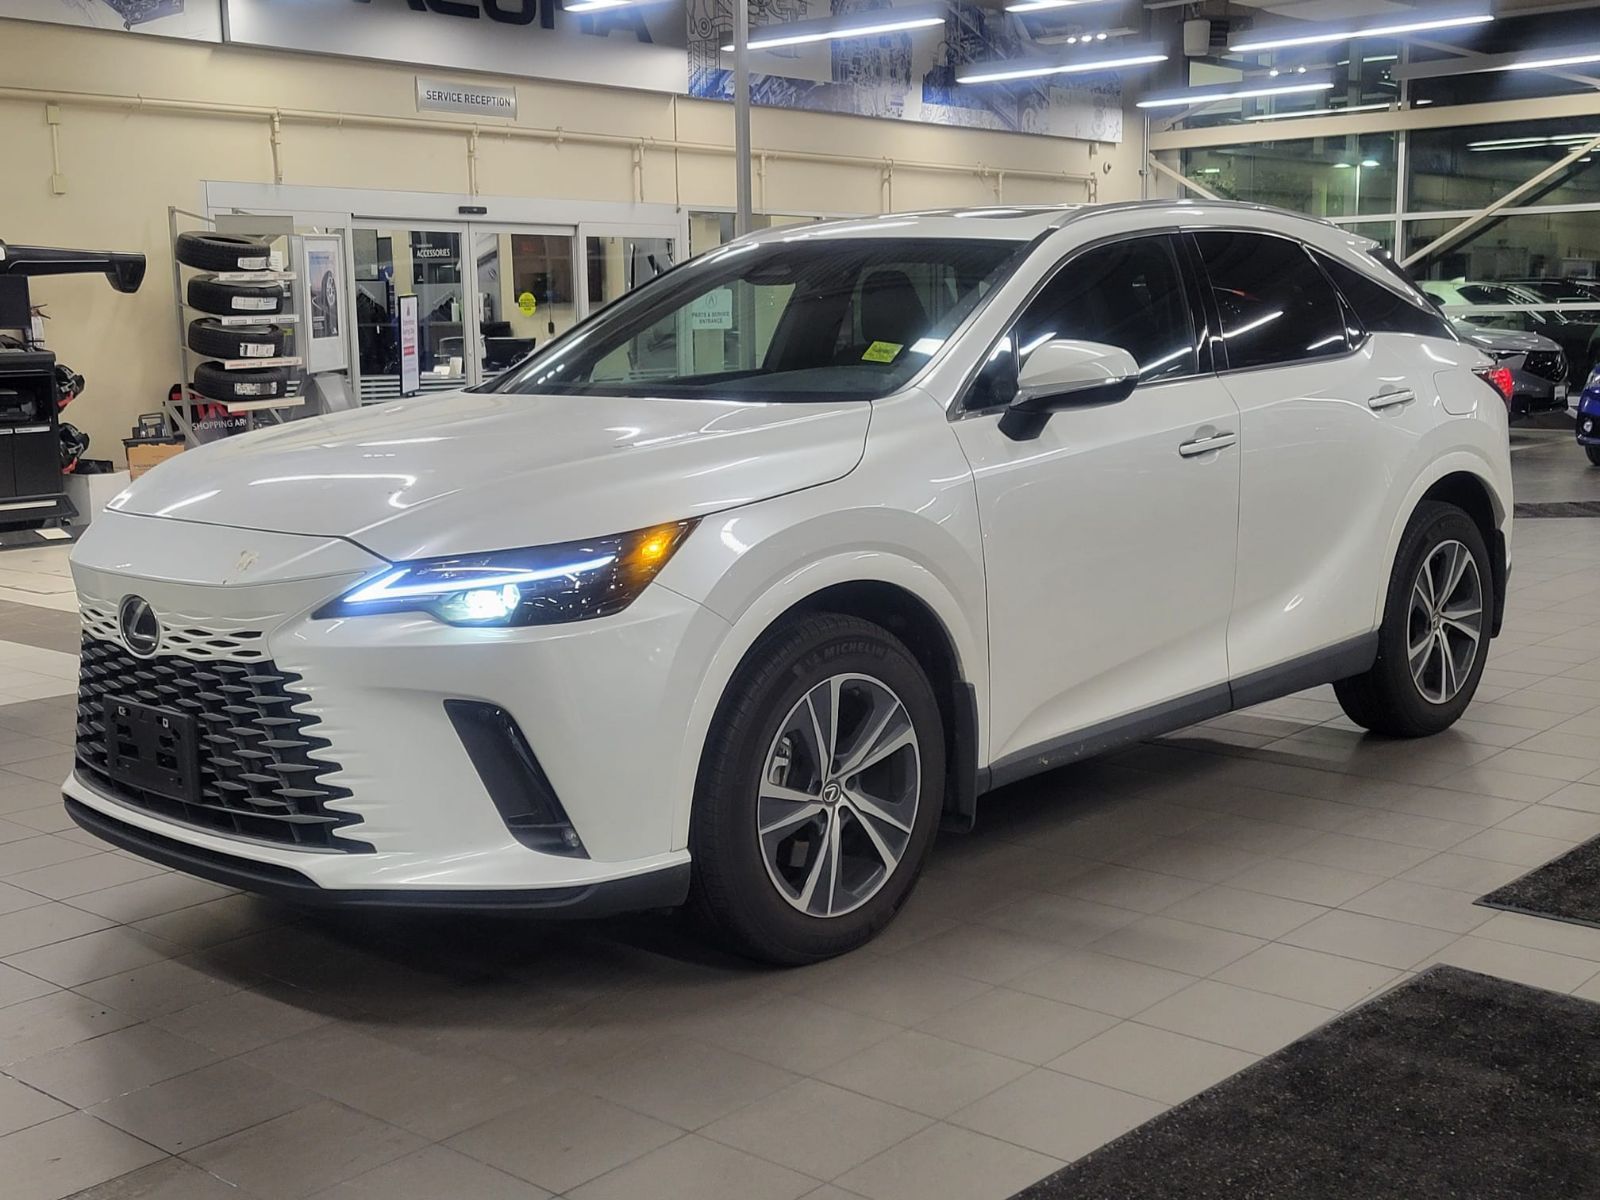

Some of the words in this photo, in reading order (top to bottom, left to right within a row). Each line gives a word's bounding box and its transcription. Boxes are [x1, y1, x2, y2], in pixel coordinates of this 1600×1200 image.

[426, 90, 463, 103] SERVICE
[464, 93, 511, 107] RECEPTION
[416, 248, 450, 258] ACCESSORIES
[699, 317, 723, 325] ENTRANCE
[191, 420, 233, 431] SHOPPING
[234, 418, 247, 427] AR
[823, 640, 887, 659] MICHELIN
